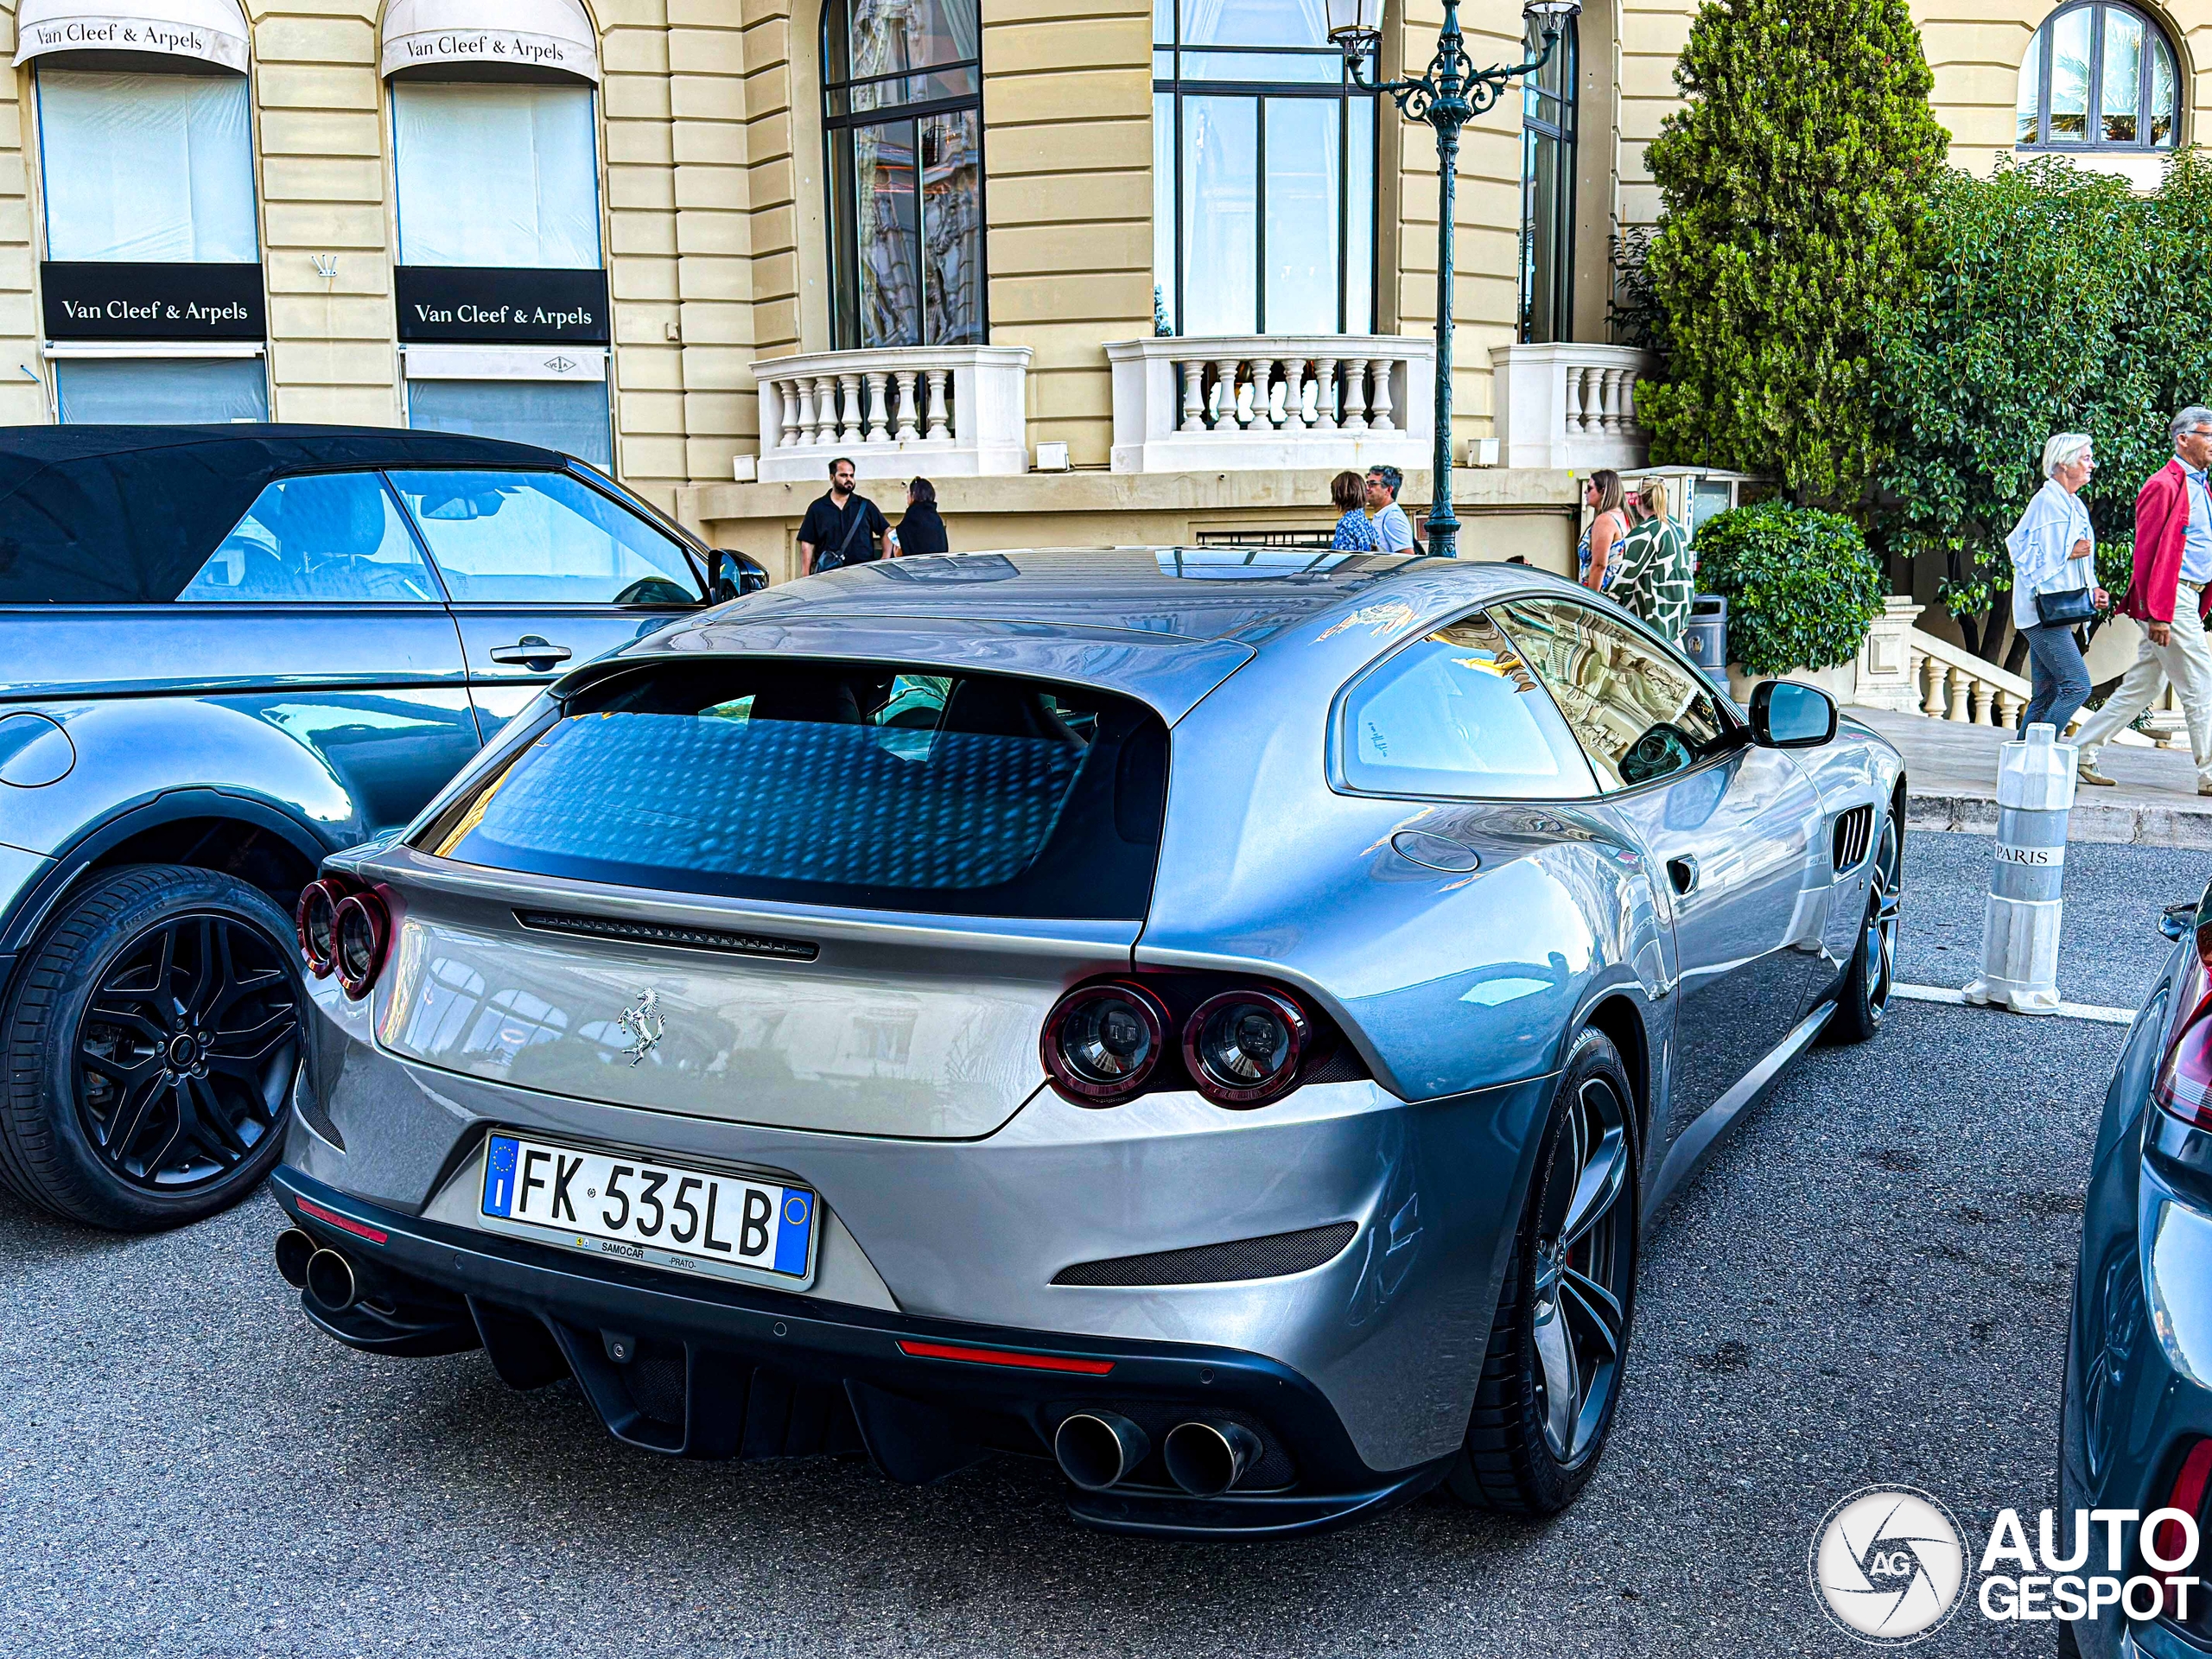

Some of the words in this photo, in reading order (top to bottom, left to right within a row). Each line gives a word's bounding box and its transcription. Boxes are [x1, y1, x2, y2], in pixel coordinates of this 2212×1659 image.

[37, 29, 61, 44] Van
[67, 24, 118, 41] Cleef
[124, 29, 137, 41] &
[143, 26, 202, 50] Arpels
[407, 41, 433, 57] Van
[438, 36, 486, 53] Cleef
[493, 41, 505, 54] &
[512, 39, 563, 61] Arpels
[62, 301, 101, 319] Van
[106, 301, 161, 319] Cleef
[166, 305, 181, 319] &
[185, 302, 248, 325] Arpels
[415, 305, 452, 322] Van
[457, 305, 509, 323] Cleef
[513, 310, 528, 323] &
[532, 307, 593, 329] Arpels
[1997, 845, 2048, 865] PARIS
[519, 1149, 583, 1223] FK
[602, 1165, 772, 1256] 535LB
[601, 1242, 645, 1259] SAMOCAR
